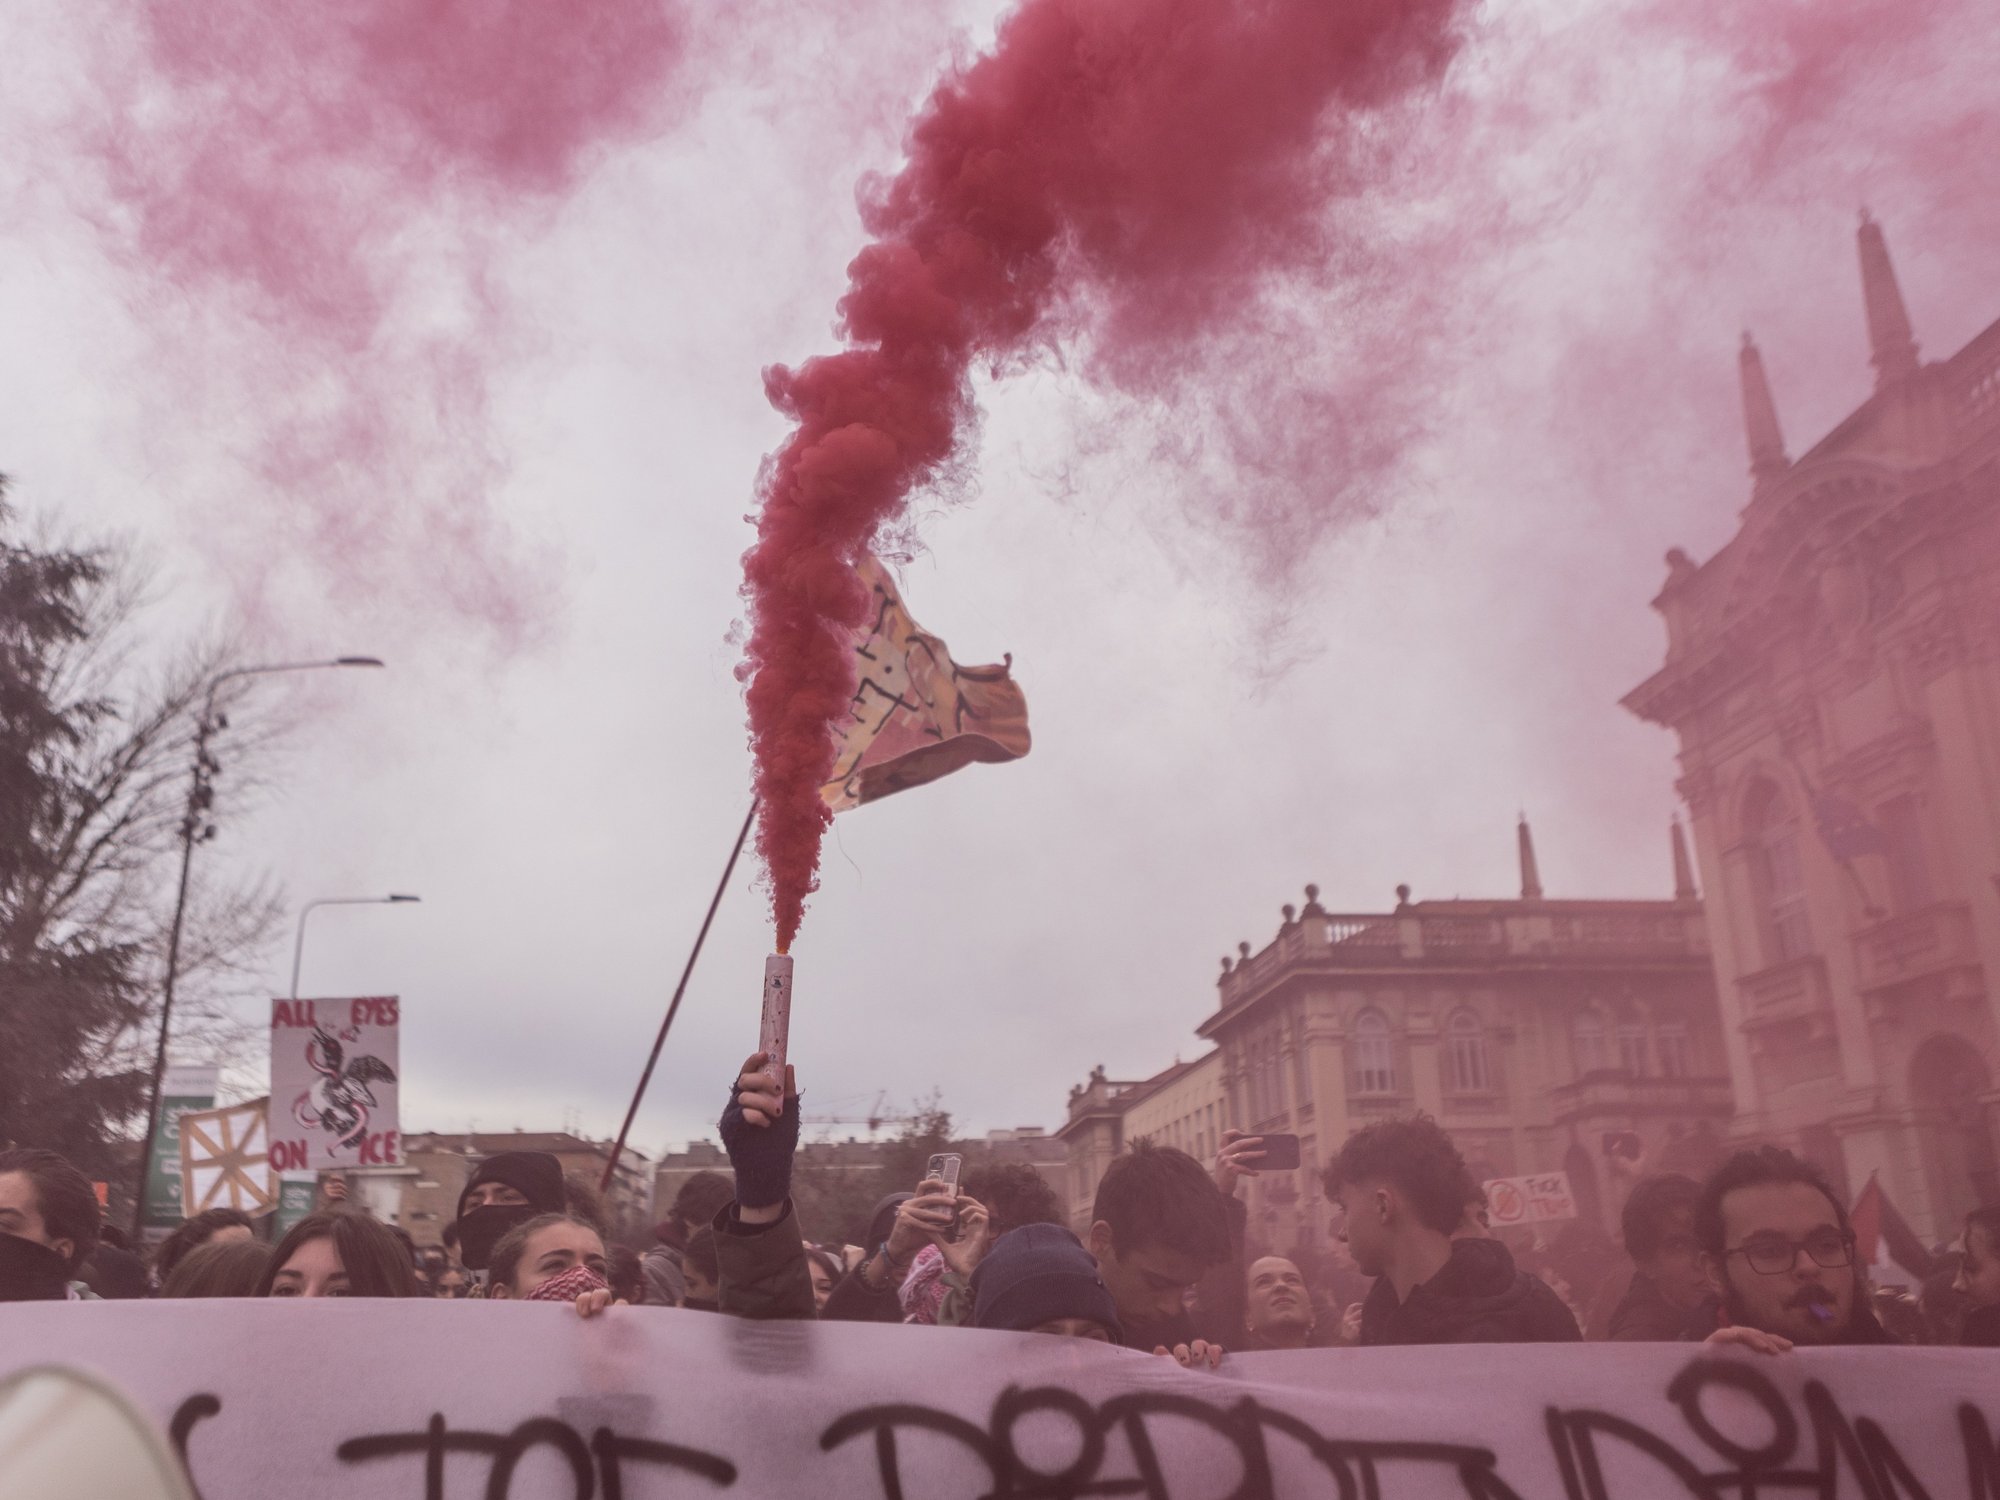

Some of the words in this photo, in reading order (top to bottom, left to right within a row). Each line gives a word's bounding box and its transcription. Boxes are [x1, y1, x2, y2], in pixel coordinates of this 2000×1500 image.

[272, 1000, 318, 1029] ALL
[352, 999, 399, 1026] EYES
[268, 1138, 308, 1172] ON
[358, 1131, 398, 1165] ICE
